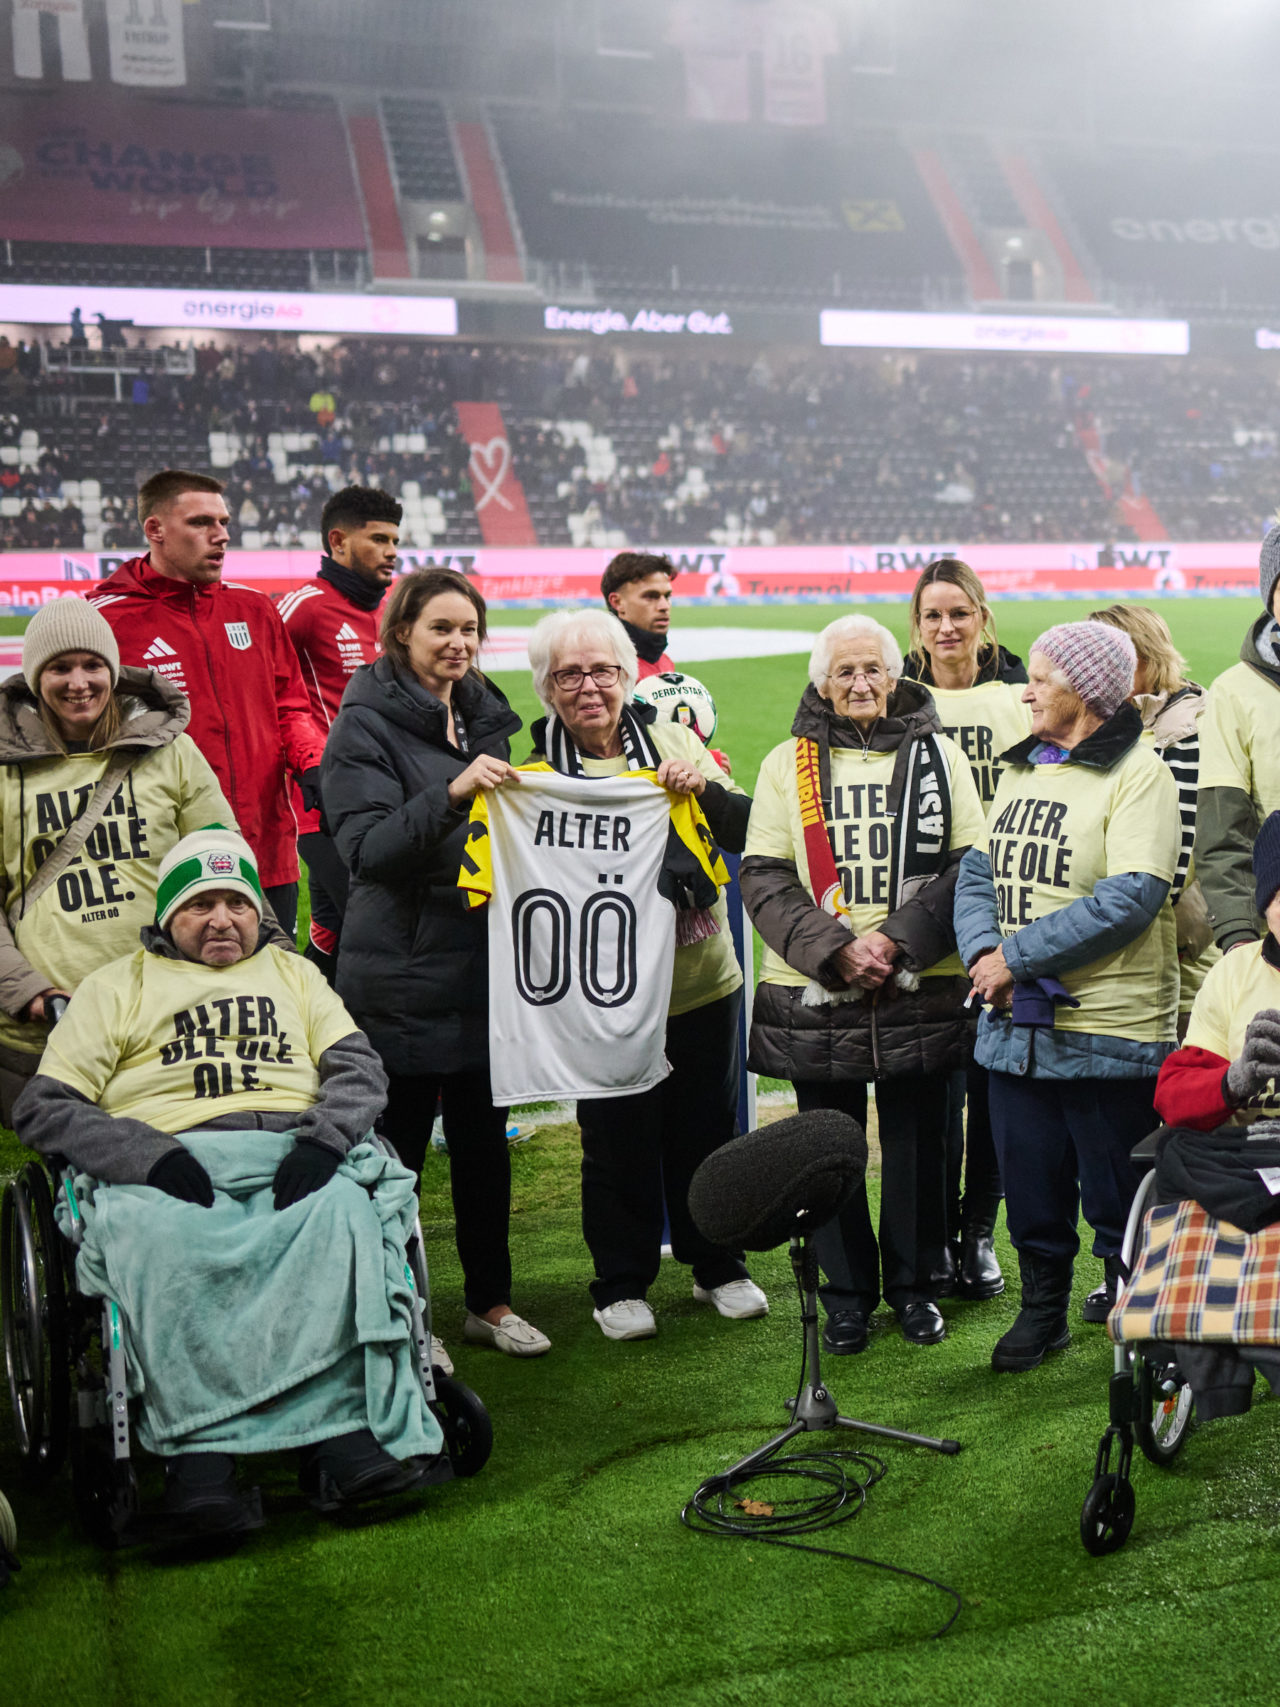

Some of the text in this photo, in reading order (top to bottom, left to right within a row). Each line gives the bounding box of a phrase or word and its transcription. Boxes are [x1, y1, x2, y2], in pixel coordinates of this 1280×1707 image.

[1192, 575, 1256, 589] Turm
[652, 686, 704, 701] DERBYSTAR
[534, 810, 632, 851] ALTER
[993, 798, 1069, 846] ALTER,
[57, 863, 136, 913] OLE.
[81, 911, 107, 924] ALTER
[173, 996, 287, 1044] ALTER,
